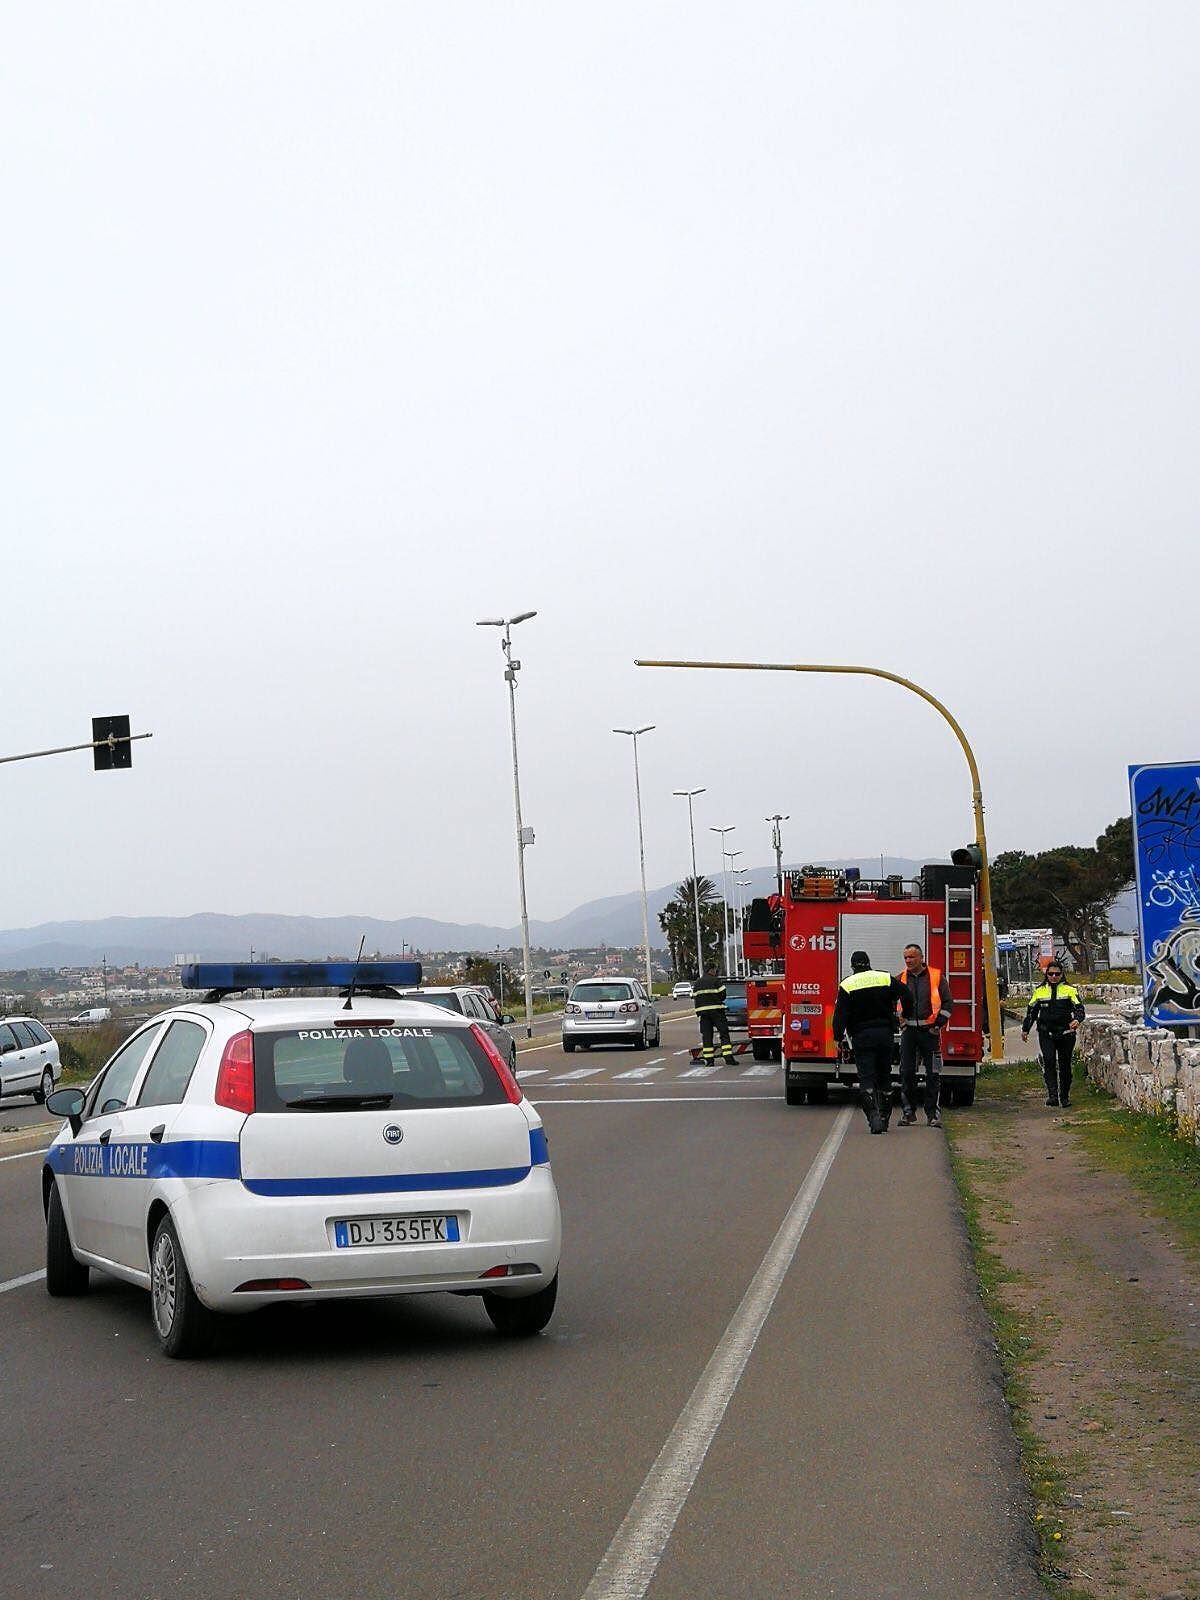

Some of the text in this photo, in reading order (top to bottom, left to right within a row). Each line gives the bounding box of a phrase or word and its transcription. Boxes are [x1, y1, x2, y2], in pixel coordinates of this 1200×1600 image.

[809, 935, 836, 951] 115
[298, 1028, 433, 1041] POLIZIA LOCALE
[386, 1130, 400, 1138] FIAT
[74, 1145, 148, 1176] POLIZIA LOCALE
